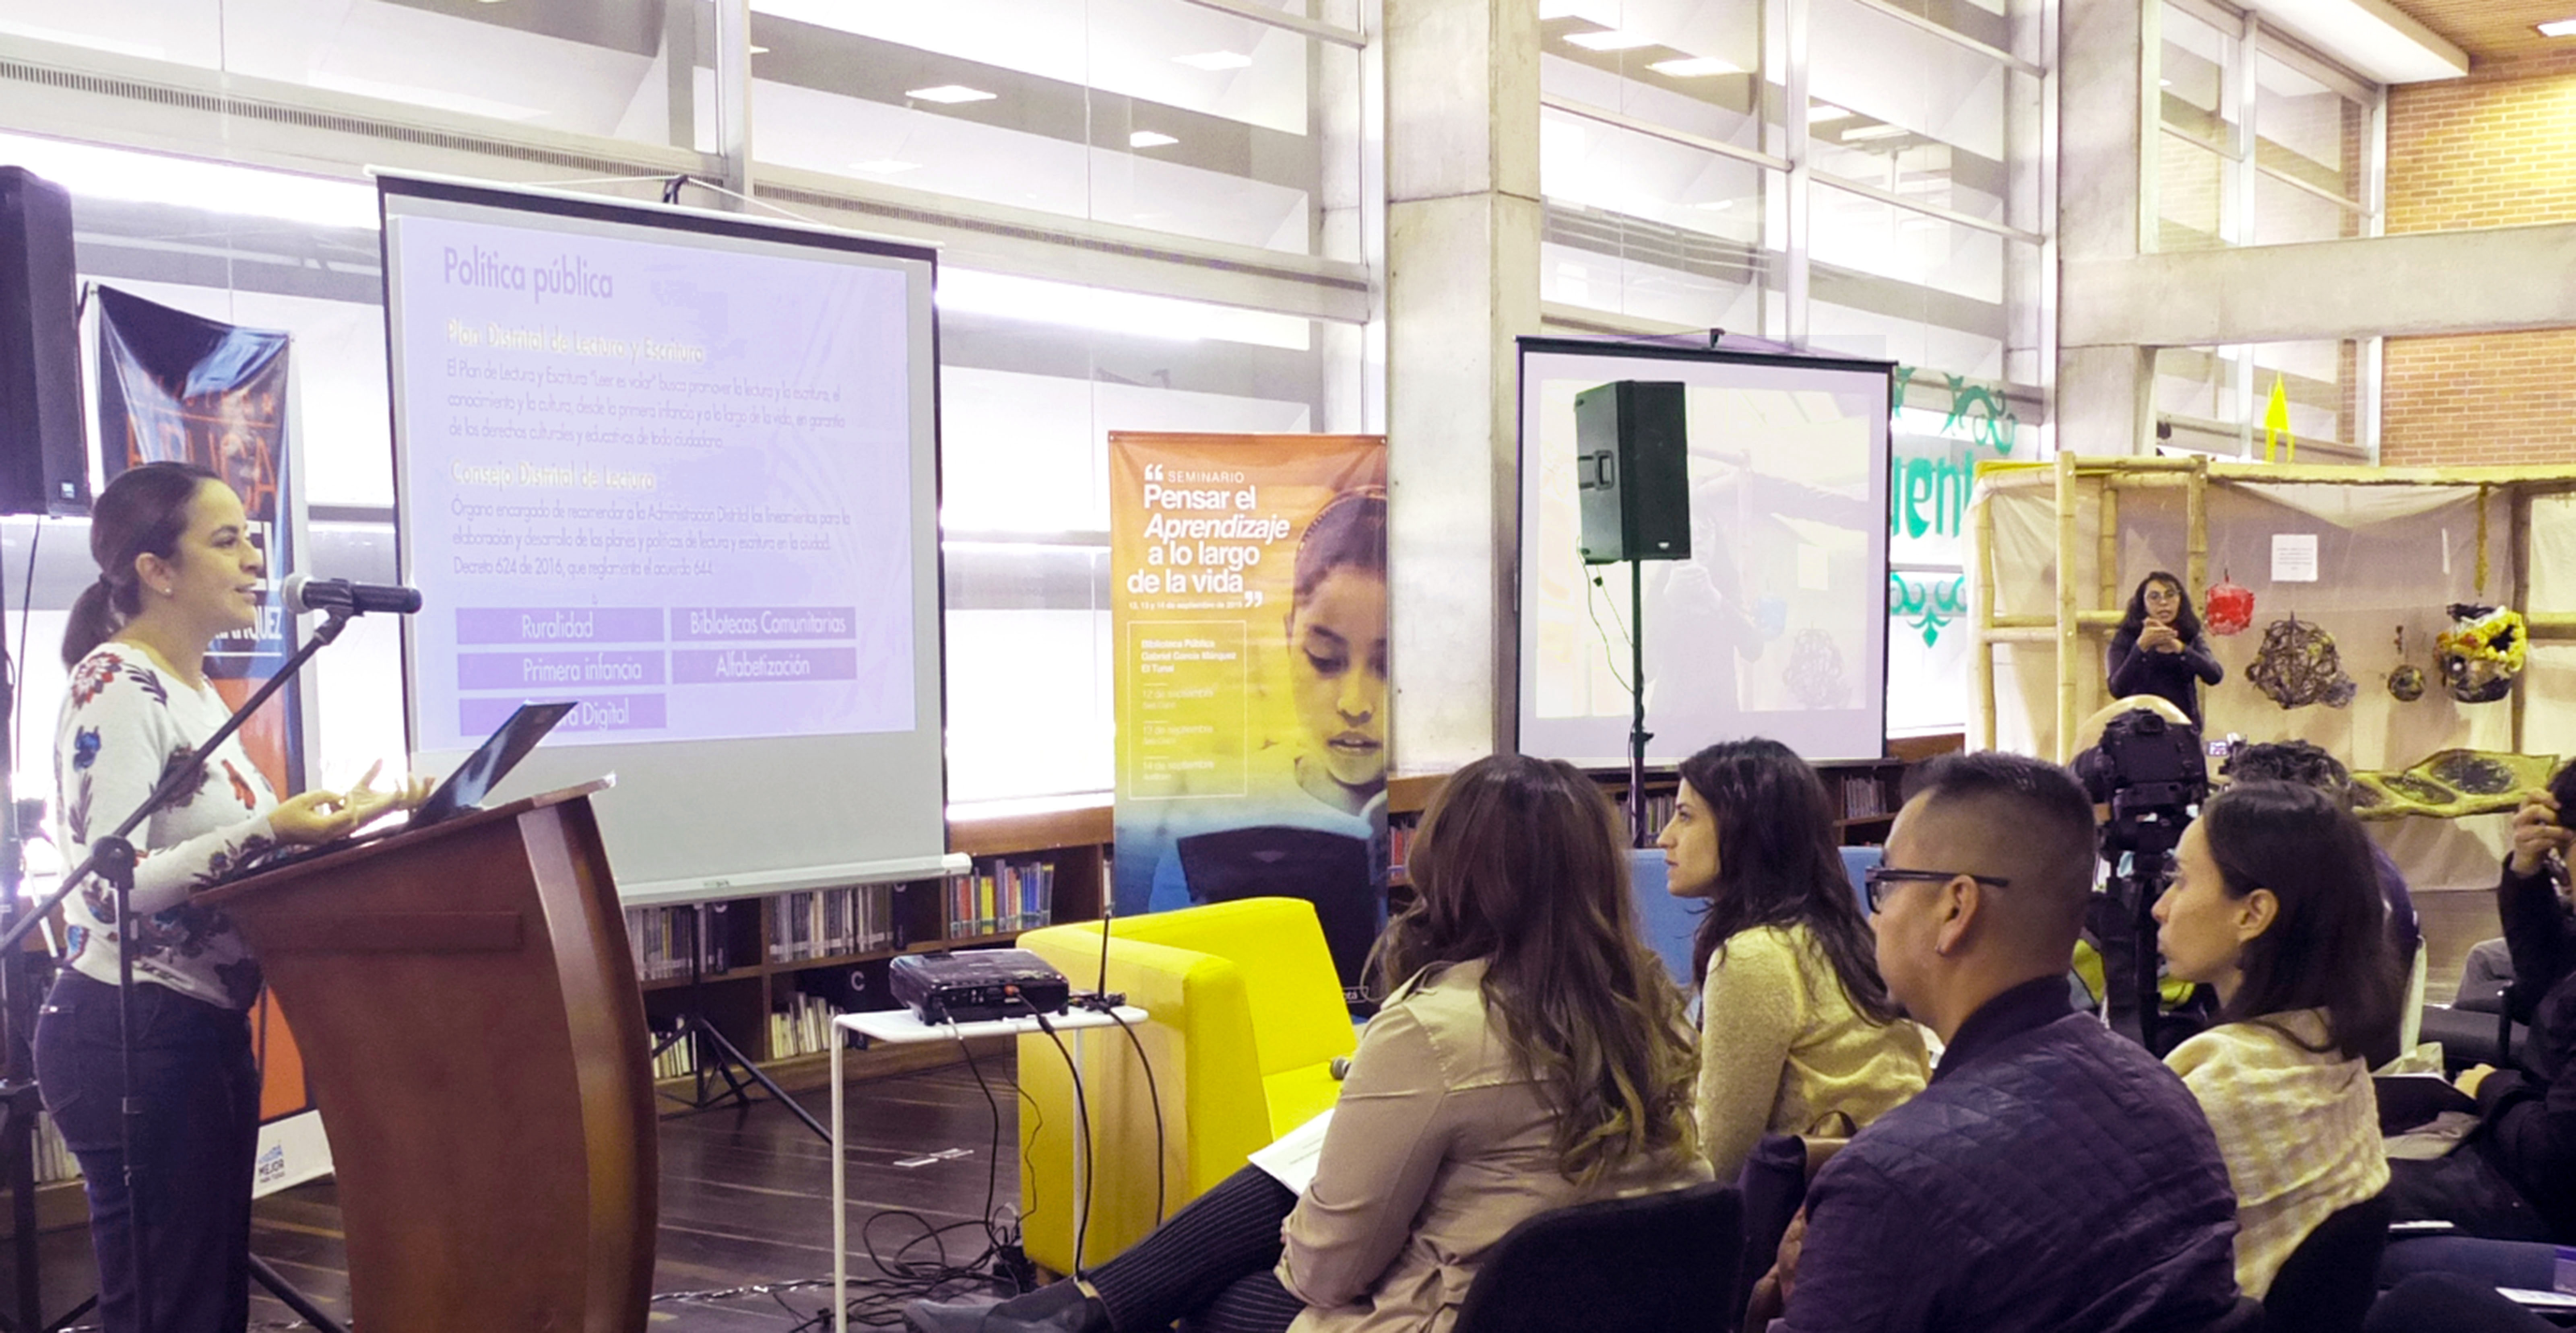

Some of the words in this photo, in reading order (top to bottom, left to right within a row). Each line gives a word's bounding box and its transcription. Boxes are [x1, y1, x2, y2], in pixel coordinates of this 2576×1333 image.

[444, 245, 525, 290] Política
[533, 254, 613, 303] pública
[447, 317, 480, 345] Plan
[486, 322, 544, 350] Distrital
[550, 326, 568, 352] de
[574, 330, 624, 357] Lectura
[630, 340, 640, 365] y
[644, 336, 703, 363] Escritura
[460, 359, 481, 379] Plan
[484, 361, 497, 380] de
[501, 363, 535, 382] Lectura
[537, 370, 544, 388] y
[547, 365, 587, 386] Escritura
[659, 372, 686, 392] busca
[689, 381, 731, 398] promover
[745, 377, 773, 398] lectura
[448, 390, 515, 410] conocimiento
[526, 391, 536, 411] la
[576, 394, 605, 415] desde
[607, 396, 616, 416] la
[619, 404, 656, 421] primera
[658, 400, 694, 420] infancia
[712, 403, 722, 422] lo
[723, 403, 746, 428] largo
[749, 405, 761, 423] de
[762, 406, 772, 425] la
[450, 416, 462, 436] de
[464, 417, 479, 437] los
[482, 417, 527, 439] derechos
[530, 420, 574, 441] culturales
[586, 424, 634, 444] educativos
[637, 426, 649, 446] de
[651, 428, 671, 445] todo
[451, 459, 513, 492] Consejo
[518, 460, 575, 487] Distrital
[580, 461, 599, 487] de
[604, 464, 654, 489] Lectura
[451, 493, 493, 522] Órgano
[496, 499, 549, 523] encargado
[553, 499, 565, 518] de
[568, 500, 623, 520] recomendar
[636, 501, 645, 520] la
[647, 502, 714, 523] Administración
[717, 505, 749, 523] Distrital
[765, 506, 817, 525] lineamientos
[820, 514, 840, 529] para
[842, 507, 851, 525] la
[1144, 484, 1230, 509] Pensar
[1235, 484, 1256, 510] el
[453, 525, 513, 545] elaboración
[524, 526, 573, 547] desarrollo
[575, 527, 588, 547] de
[590, 527, 603, 547] los
[606, 528, 637, 553] planes
[646, 527, 683, 553] políticas
[685, 529, 697, 550] de
[699, 529, 729, 550] lectura
[739, 532, 775, 550] escritura
[789, 531, 798, 550] la
[1143, 513, 1290, 545] Aprendizaje
[454, 556, 493, 575] Decreto
[495, 557, 517, 574] 624
[519, 554, 532, 575] de
[567, 562, 587, 579] que
[589, 556, 641, 580] reglamenta
[654, 557, 691, 575] acuerdo
[1148, 546, 1164, 565] a
[1170, 541, 1193, 565] lo
[1198, 541, 1261, 572] largo
[1127, 568, 1160, 593] de
[1165, 568, 1187, 593] la
[523, 612, 594, 638] Ruralidad
[761, 610, 846, 635] Comunitarias
[524, 658, 581, 682] Primera
[584, 653, 642, 680] infancia
[716, 653, 811, 677] Alfabetización
[583, 696, 629, 731] Digital
[850, 970, 866, 992] C
